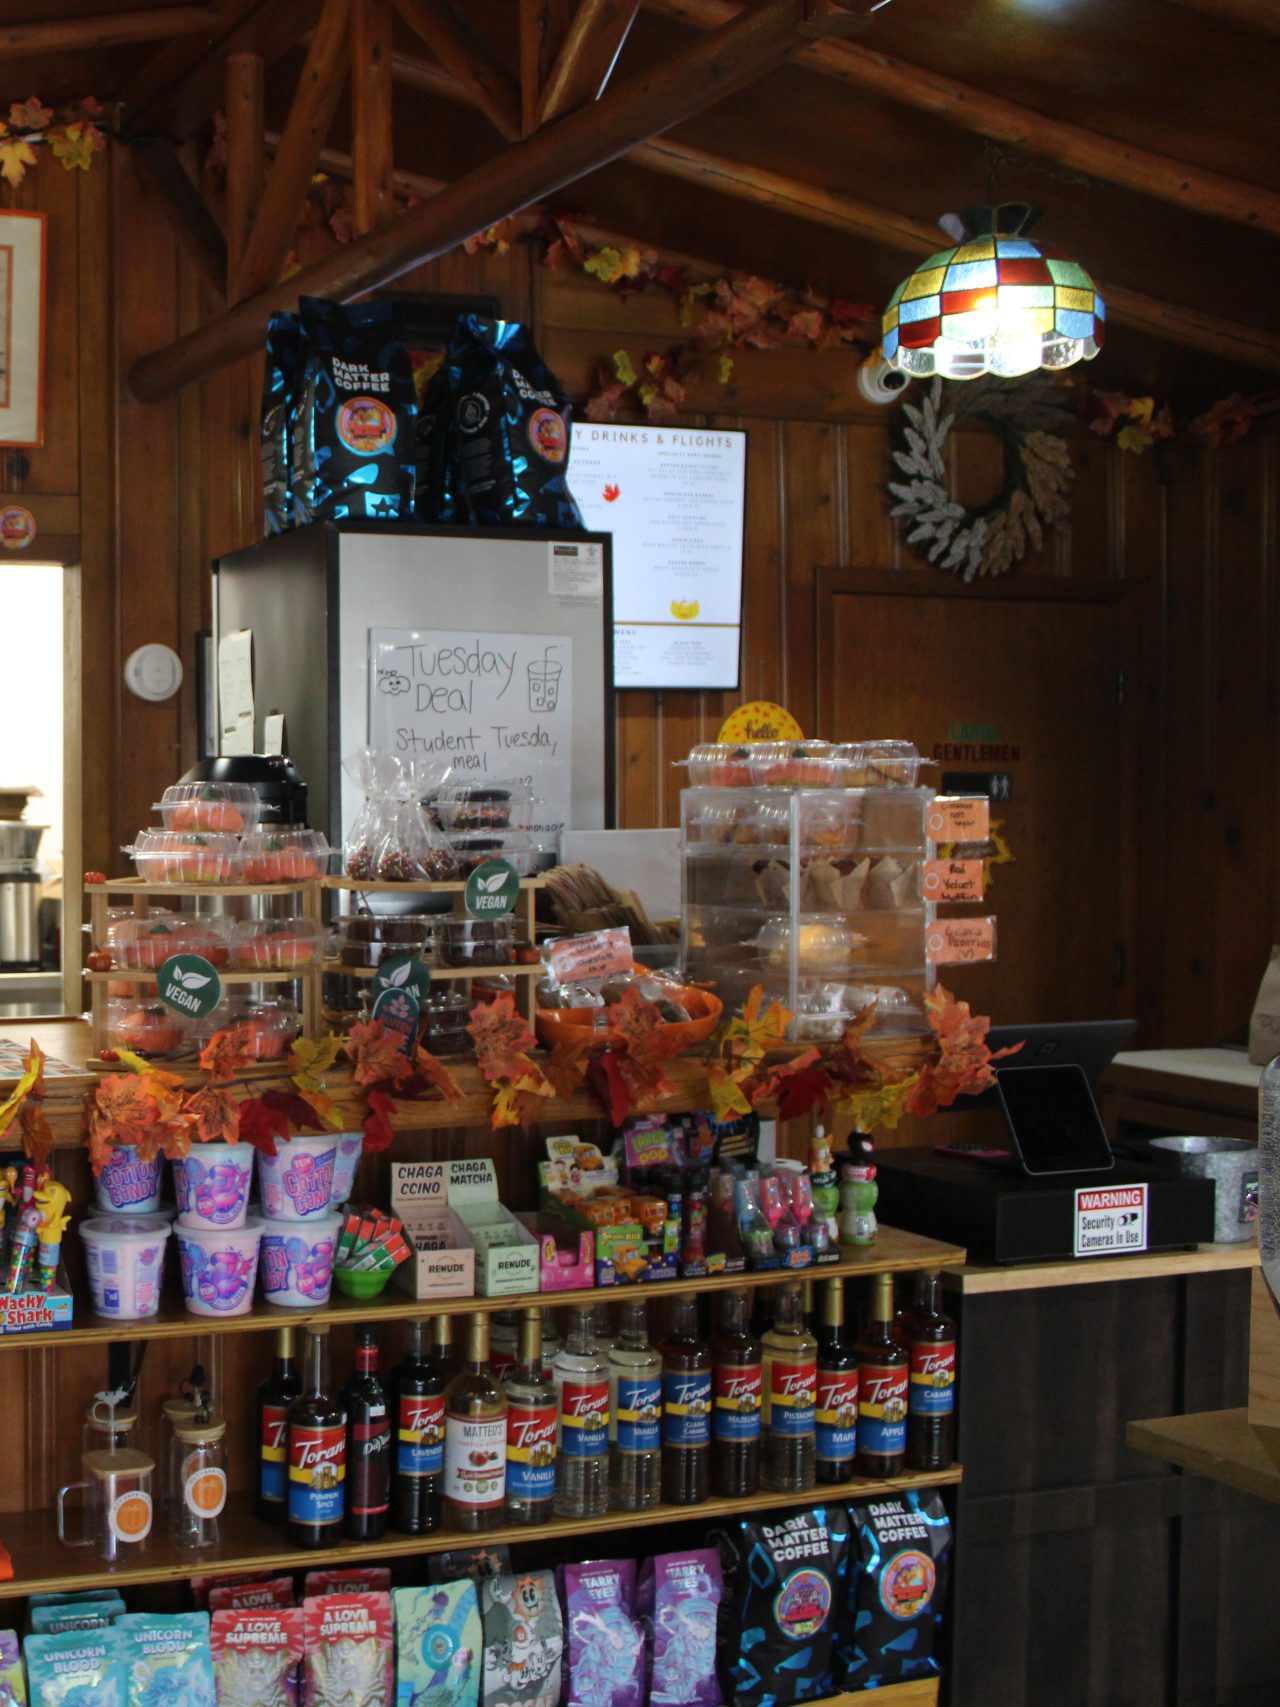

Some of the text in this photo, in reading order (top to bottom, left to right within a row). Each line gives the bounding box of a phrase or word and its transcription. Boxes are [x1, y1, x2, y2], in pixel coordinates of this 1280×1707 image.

[332, 357, 369, 372] DARK
[333, 367, 390, 382] MATTER
[335, 378, 390, 392] COFFEE
[592, 431, 648, 443] DRINKS
[657, 435, 664, 444] &
[673, 435, 732, 448] FLIGHTS
[396, 639, 516, 701] Tuesday
[415, 680, 473, 714] Deal
[744, 720, 780, 740] hello
[396, 727, 481, 752] Student
[453, 752, 488, 771] meal
[476, 896, 508, 909] VEGAN
[165, 983, 202, 1012] VEGAN
[398, 1166, 443, 1178] CHAGA
[451, 1162, 487, 1173] CHAGA
[450, 1173, 493, 1185] MATCHA
[400, 1182, 440, 1194] CCINO
[1081, 1190, 1141, 1209] WARNING
[1082, 1215, 1115, 1230] Security
[1082, 1234, 1113, 1248] Cameras
[1126, 1230, 1139, 1244] Use
[429, 1264, 465, 1273] RENUDE
[498, 1259, 531, 1270] RENUDE
[7, 1308, 53, 1326] Shark
[820, 1383, 858, 1411] Toran
[577, 1433, 605, 1441] VANILLA
[881, 1426, 904, 1437] APPLE
[295, 1433, 346, 1469] Torani
[869, 1501, 905, 1516] DARK
[762, 1516, 808, 1538] DARK
[873, 1511, 924, 1529] MATTER
[768, 1527, 828, 1549] MATTER
[878, 1526, 928, 1543] COFFEE
[773, 1541, 830, 1562] COFFEE
[338, 1584, 369, 1593] LOVE
[233, 1599, 241, 1609] A
[244, 1593, 273, 1606] LOVE
[324, 1609, 369, 1622] A LOVE
[49, 1618, 110, 1634] UNICORN
[234, 1622, 282, 1632] A LOVE
[321, 1621, 377, 1635] SUPREME
[134, 1629, 193, 1642] UNICORN
[225, 1633, 288, 1643] SUPREME
[44, 1645, 106, 1662] UNICORN
[143, 1640, 186, 1654] BLOOD
[54, 1659, 100, 1673] BLOOD
